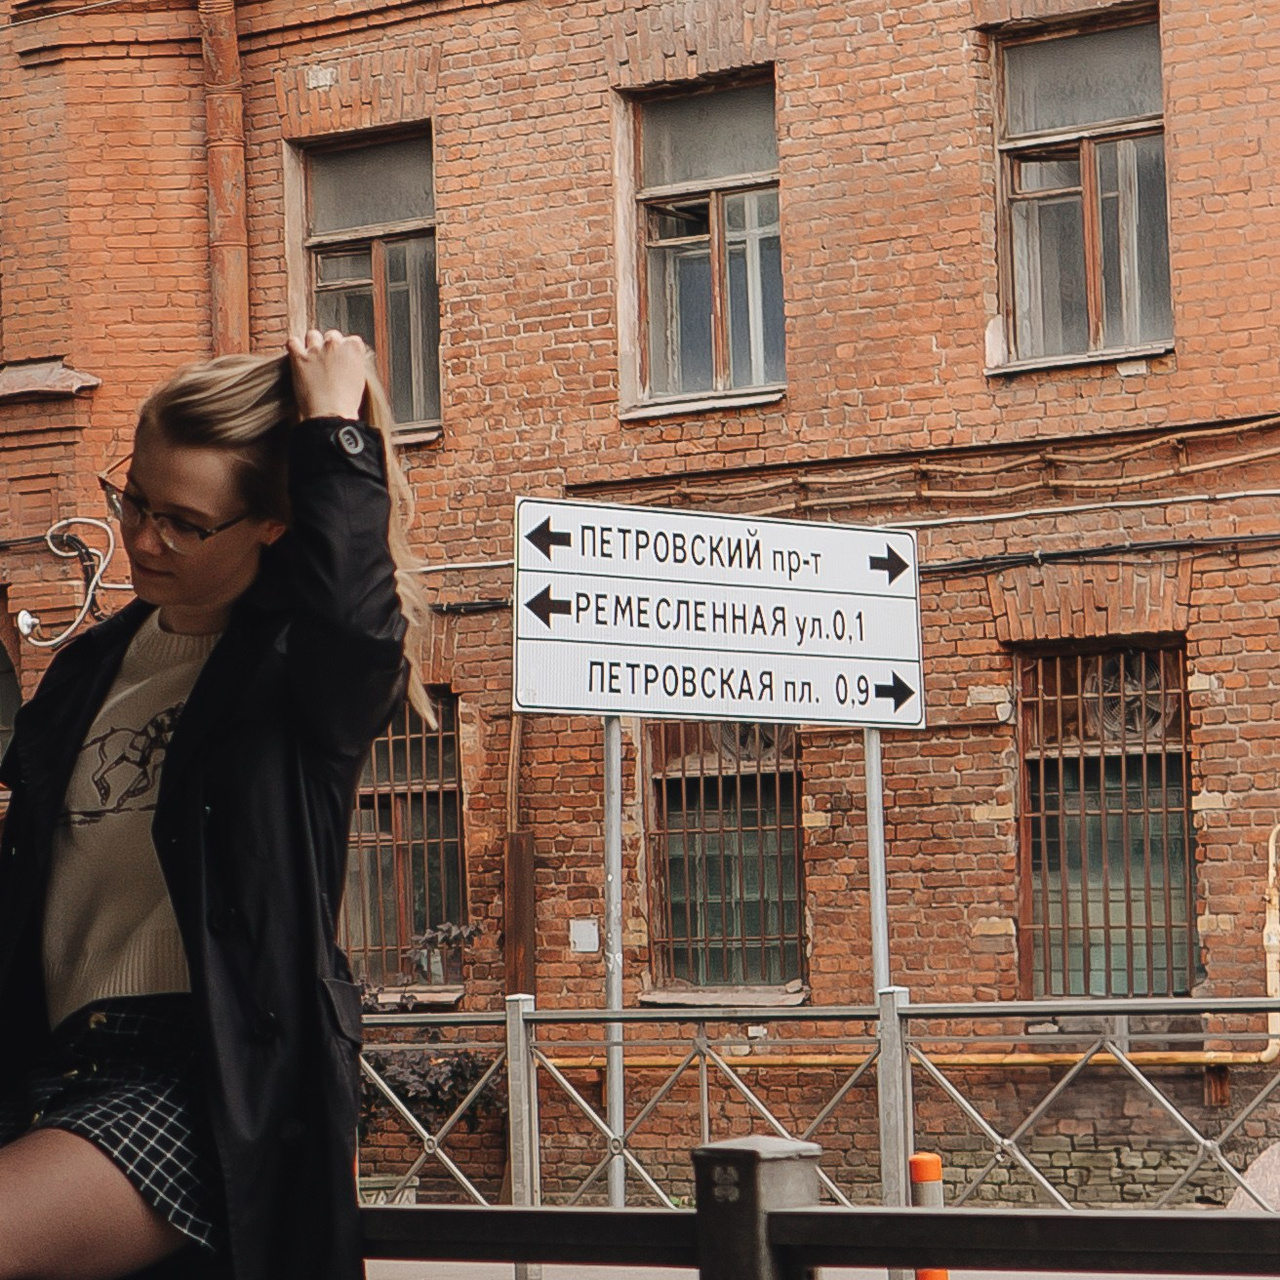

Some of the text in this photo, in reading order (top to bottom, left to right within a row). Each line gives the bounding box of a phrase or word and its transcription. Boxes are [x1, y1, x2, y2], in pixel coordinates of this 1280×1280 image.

[581, 525, 822, 581] ПЕТРОВСКИЙ пр-т
[575, 592, 787, 637] РЕМЕСЛЕННАЯ
[588, 660, 870, 709] ПЕТРОВСКАЯ пл. 0,9
